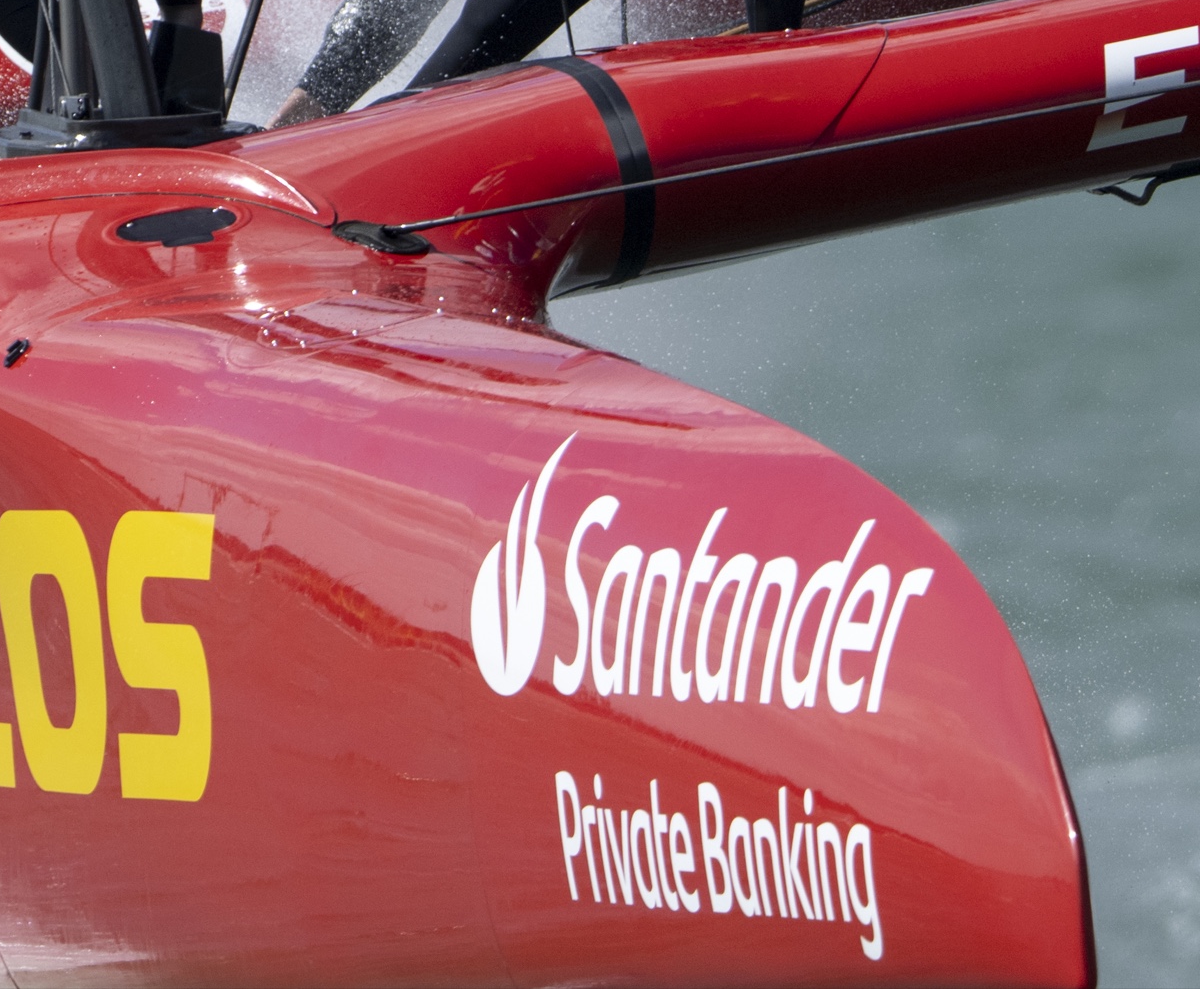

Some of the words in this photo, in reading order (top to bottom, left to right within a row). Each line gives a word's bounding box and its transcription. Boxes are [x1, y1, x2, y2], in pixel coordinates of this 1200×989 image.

[552, 495, 934, 713] Santander
[554, 770, 701, 913] Private
[697, 781, 884, 961] Banking
